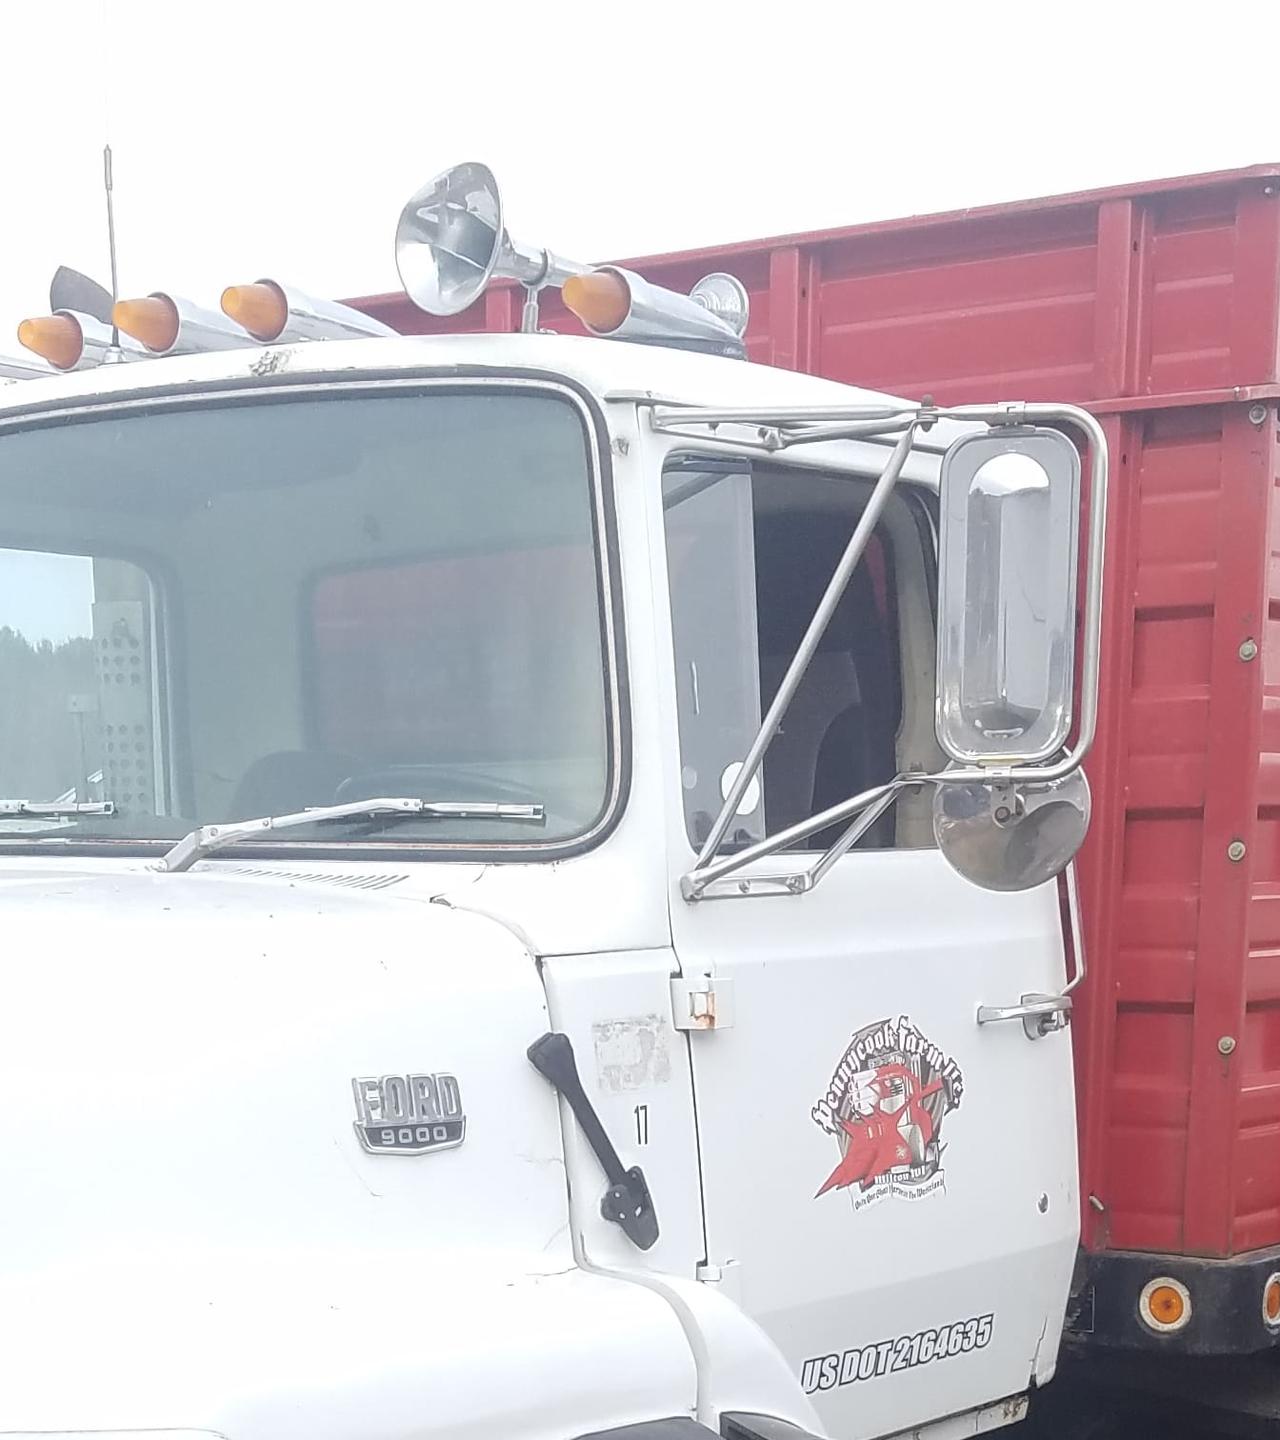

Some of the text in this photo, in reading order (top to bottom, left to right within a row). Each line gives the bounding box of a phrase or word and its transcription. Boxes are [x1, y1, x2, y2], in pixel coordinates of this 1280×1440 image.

[351, 1072, 463, 1124] FORD
[381, 1126, 448, 1145] 9000
[801, 1313, 995, 1395] US DOT 2164635
